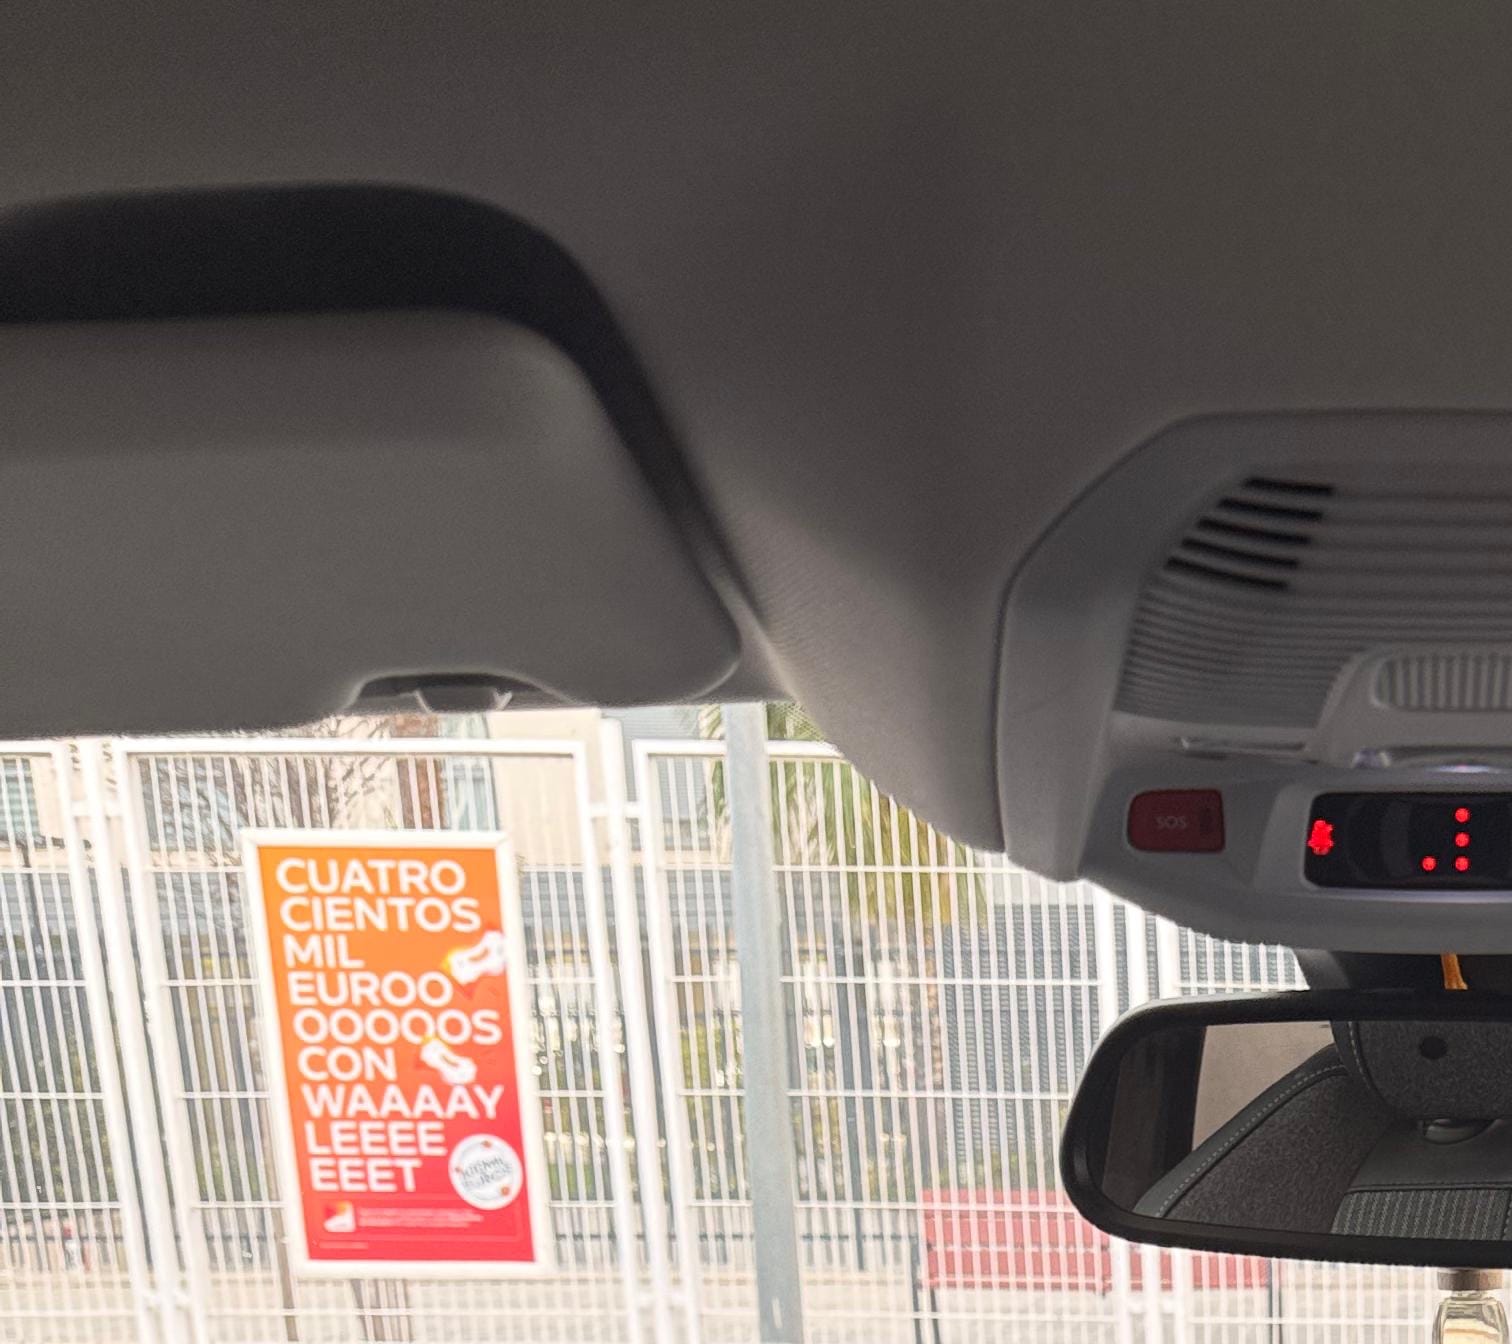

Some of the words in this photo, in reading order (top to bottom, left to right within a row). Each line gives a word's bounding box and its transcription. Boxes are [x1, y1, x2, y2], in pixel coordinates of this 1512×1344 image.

[1155, 815, 1187, 829] SOS
[276, 858, 467, 895] CUATRO
[279, 897, 482, 933] CIENTOS
[283, 934, 365, 969] MIL
[289, 971, 453, 1007] EUROO
[293, 1009, 503, 1046] OOOOOS
[297, 1047, 397, 1082] CON
[302, 1085, 505, 1120] WAAAAY
[305, 1121, 447, 1156] LEEEE
[310, 1158, 422, 1193] EEET
